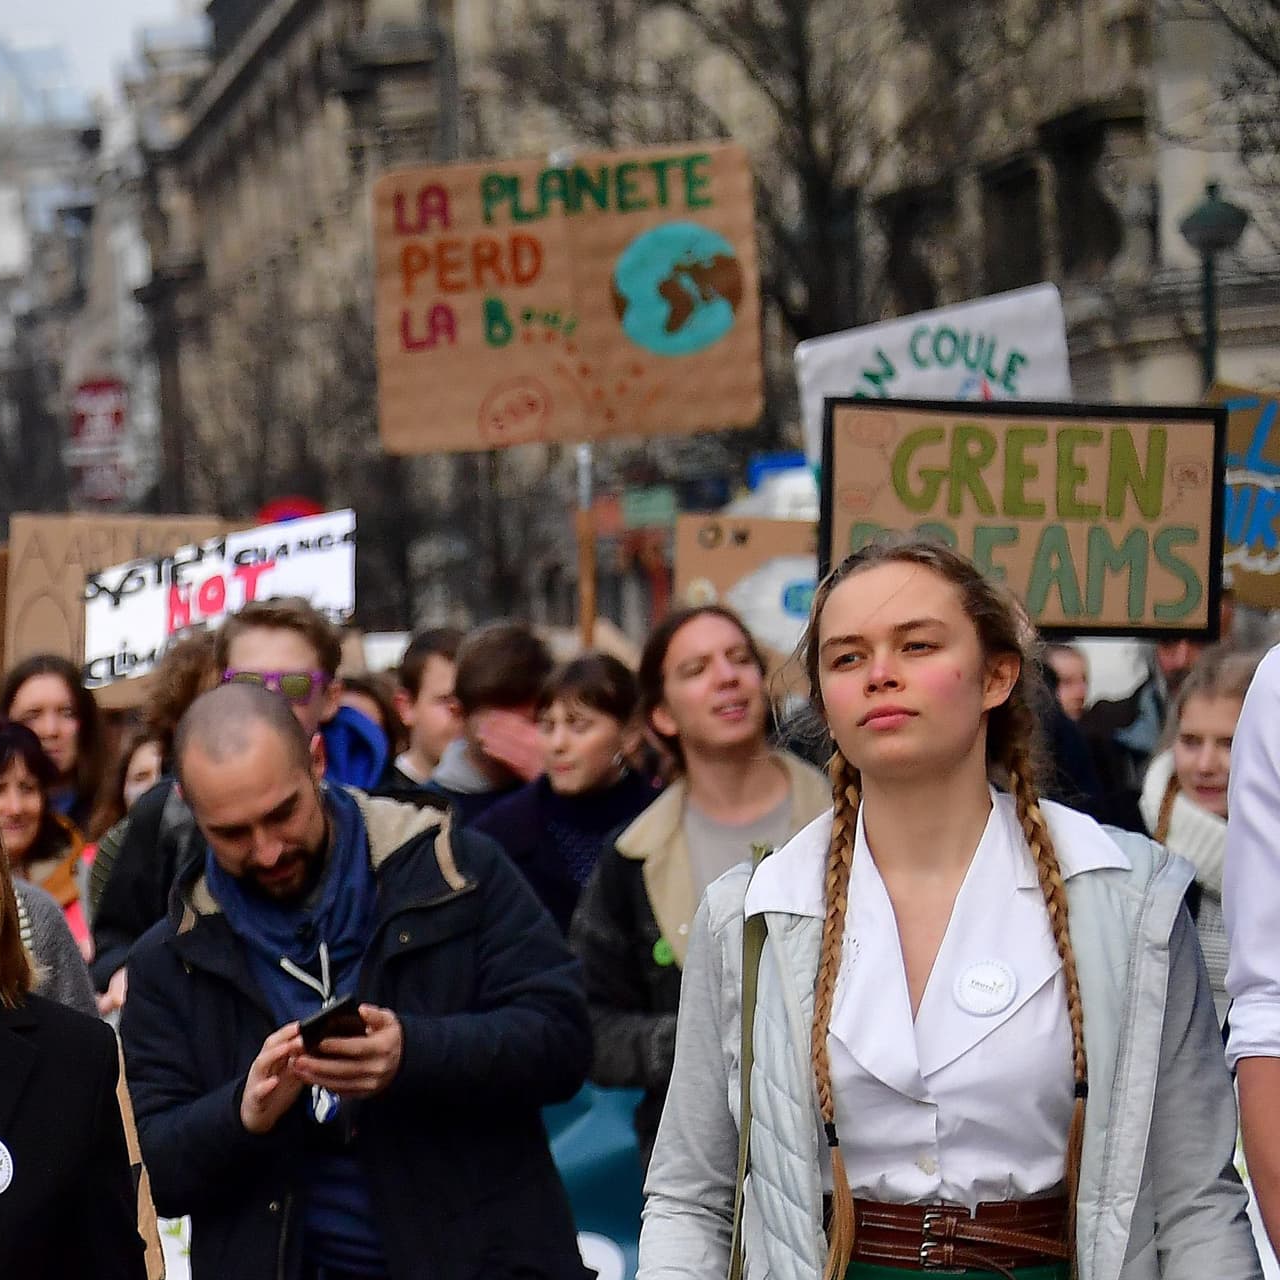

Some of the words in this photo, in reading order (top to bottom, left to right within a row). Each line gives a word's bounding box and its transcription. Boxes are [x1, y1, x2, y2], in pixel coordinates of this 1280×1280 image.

[396, 184, 450, 235] LA
[481, 154, 712, 226] PLANETE
[401, 233, 540, 297] PERD
[401, 303, 457, 352] LA
[853, 349, 897, 397] N
[910, 326, 1028, 392] COULE
[892, 425, 1167, 521] GREEN
[168, 560, 276, 635] NOT
